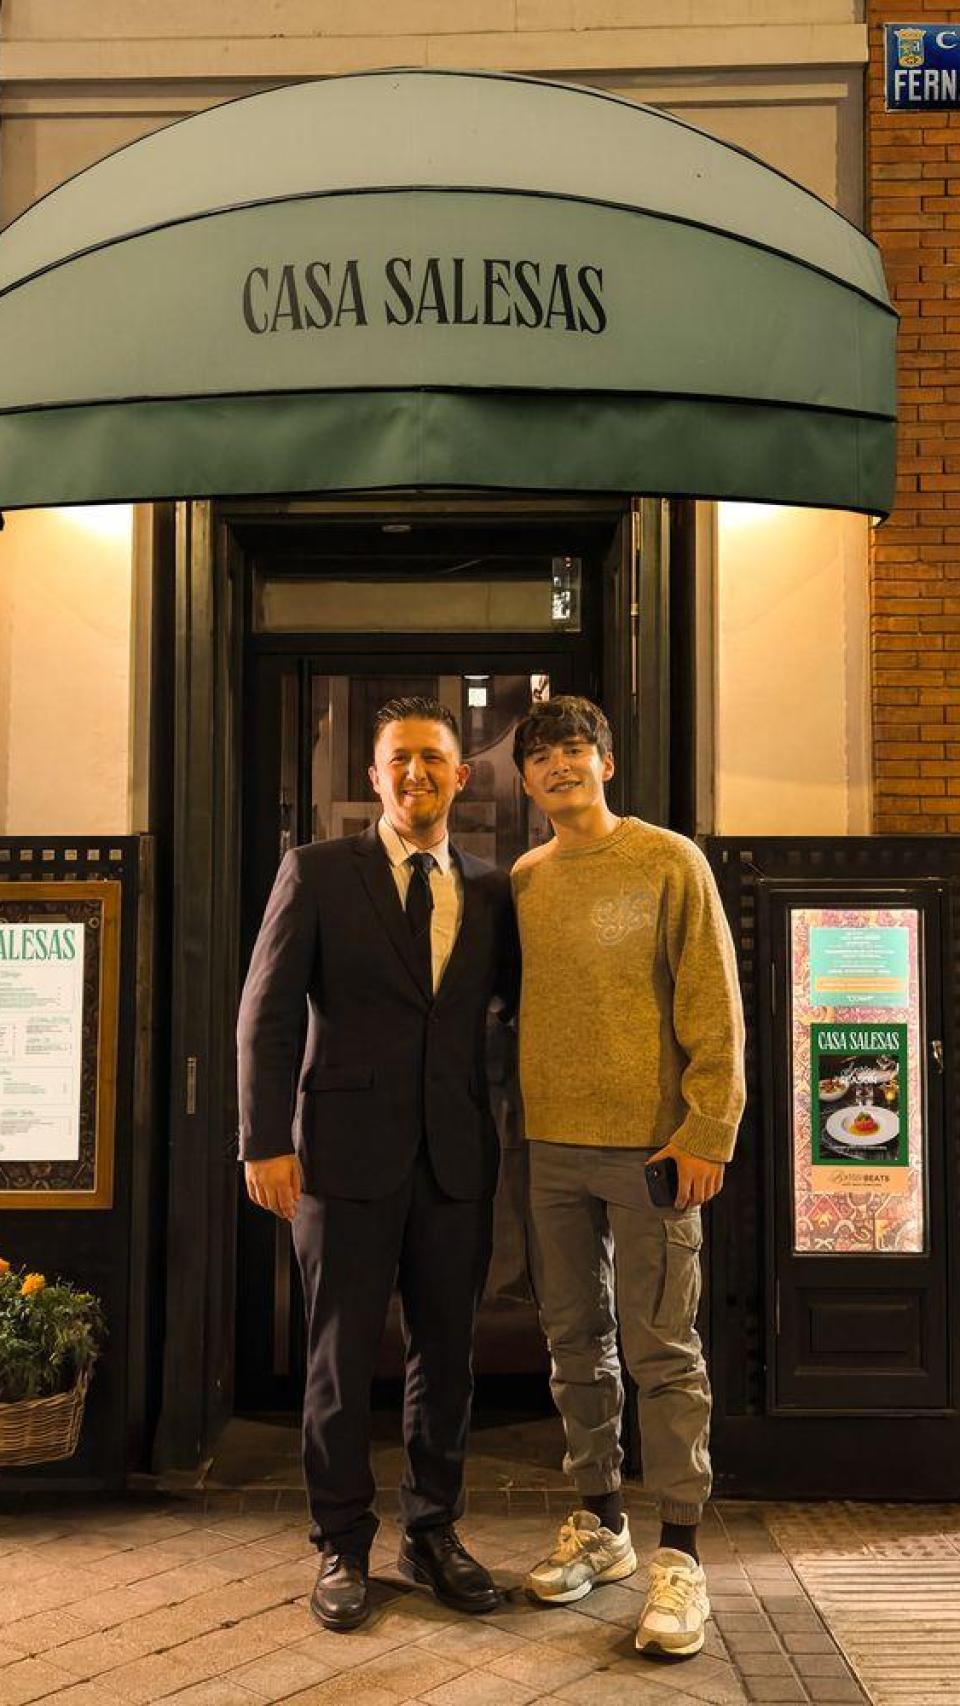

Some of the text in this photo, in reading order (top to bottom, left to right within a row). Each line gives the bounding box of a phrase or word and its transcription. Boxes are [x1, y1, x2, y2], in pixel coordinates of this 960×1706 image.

[242, 256, 608, 335] CASA SALESAS
[818, 1031, 900, 1050] CASA SALESAS
